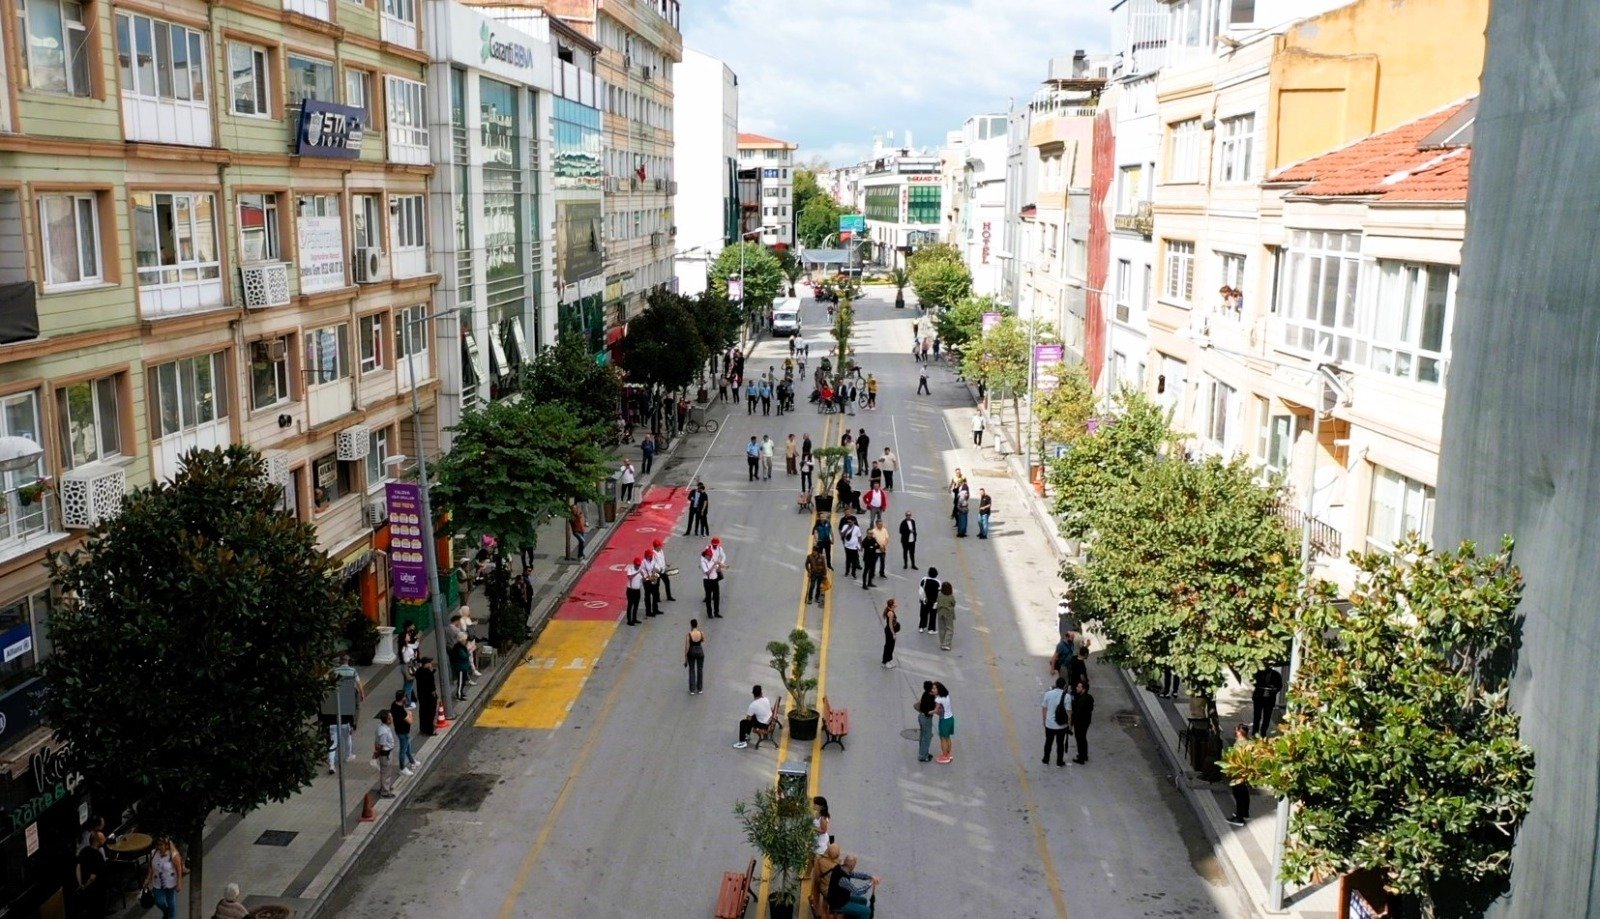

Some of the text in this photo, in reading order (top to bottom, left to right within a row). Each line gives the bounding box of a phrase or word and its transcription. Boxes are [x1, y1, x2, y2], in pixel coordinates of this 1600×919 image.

[489, 32, 533, 69] Garanti BBVA
[981, 221, 992, 264] HOTEL
